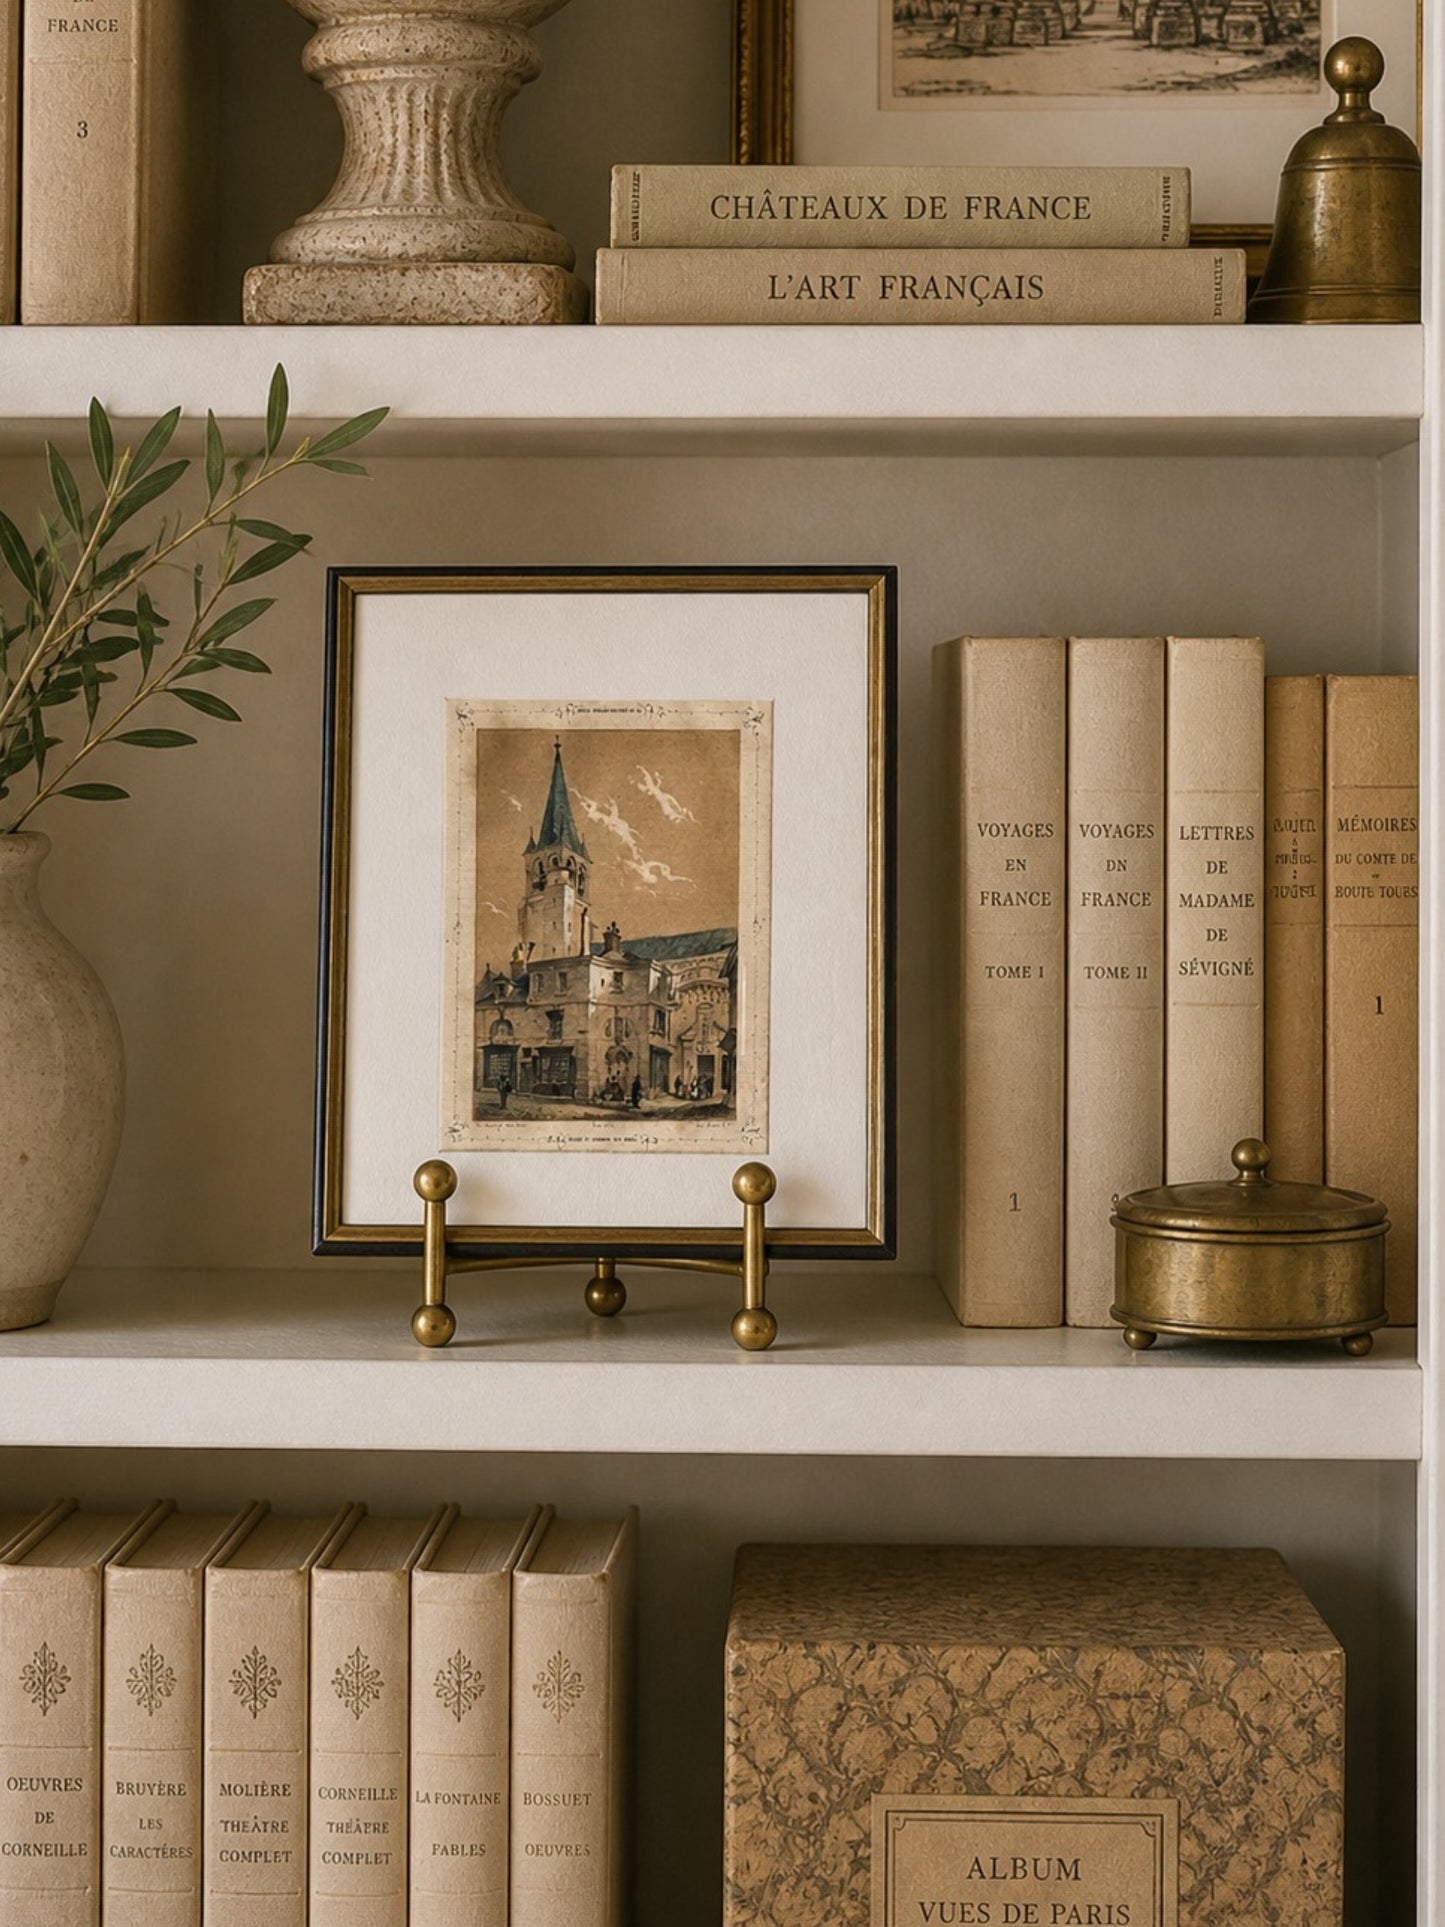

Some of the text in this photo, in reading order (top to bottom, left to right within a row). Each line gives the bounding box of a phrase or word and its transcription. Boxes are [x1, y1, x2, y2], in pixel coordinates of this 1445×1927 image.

[47, 18, 118, 33] FRANCE
[76, 120, 89, 139] 3
[711, 191, 1091, 221] CHÂTEAUX DE FRANCE
[879, 275, 1044, 306] FRANÇAIS
[977, 823, 1054, 838] VOYAGES
[1336, 814, 1417, 832] MÉMOIRES
[1079, 824, 1155, 839] VOYAGES
[1179, 825, 1255, 841] LETTRES
[1005, 859, 1027, 872] EN
[1401, 852, 1417, 865] DE
[1206, 860, 1228, 875] DE
[980, 891, 1052, 906] FRANCE
[1081, 892, 1152, 907] FRANCE
[1179, 893, 1255, 908] MADAME
[1206, 928, 1228, 942] DE
[985, 966, 1044, 979] TOME I
[1084, 966, 1130, 979] TOME
[1178, 957, 1254, 976] SÉVIGNÉ
[1375, 995, 1384, 1015] 1
[1009, 1192, 1021, 1212] 1
[6, 1777, 83, 1792] OEUVRES
[116, 1780, 187, 1797] BRUYÈRE
[219, 1780, 292, 1797] MOLIÈRE
[318, 1787, 398, 1801] CORNEILLE
[415, 1791, 500, 1806] LA FONTAINE
[523, 1792, 592, 1806] BOSSUET
[35, 1811, 55, 1825] DE
[138, 1818, 163, 1830] LES
[1, 1843, 88, 1858] CORNEILLE
[219, 1850, 293, 1864] COMPLET
[524, 1843, 591, 1857] OEUVRES
[321, 1851, 392, 1865] COMPLET
[966, 1857, 1081, 1881] ALBUM
[919, 1901, 1131, 1926] VUES DE PARIS
